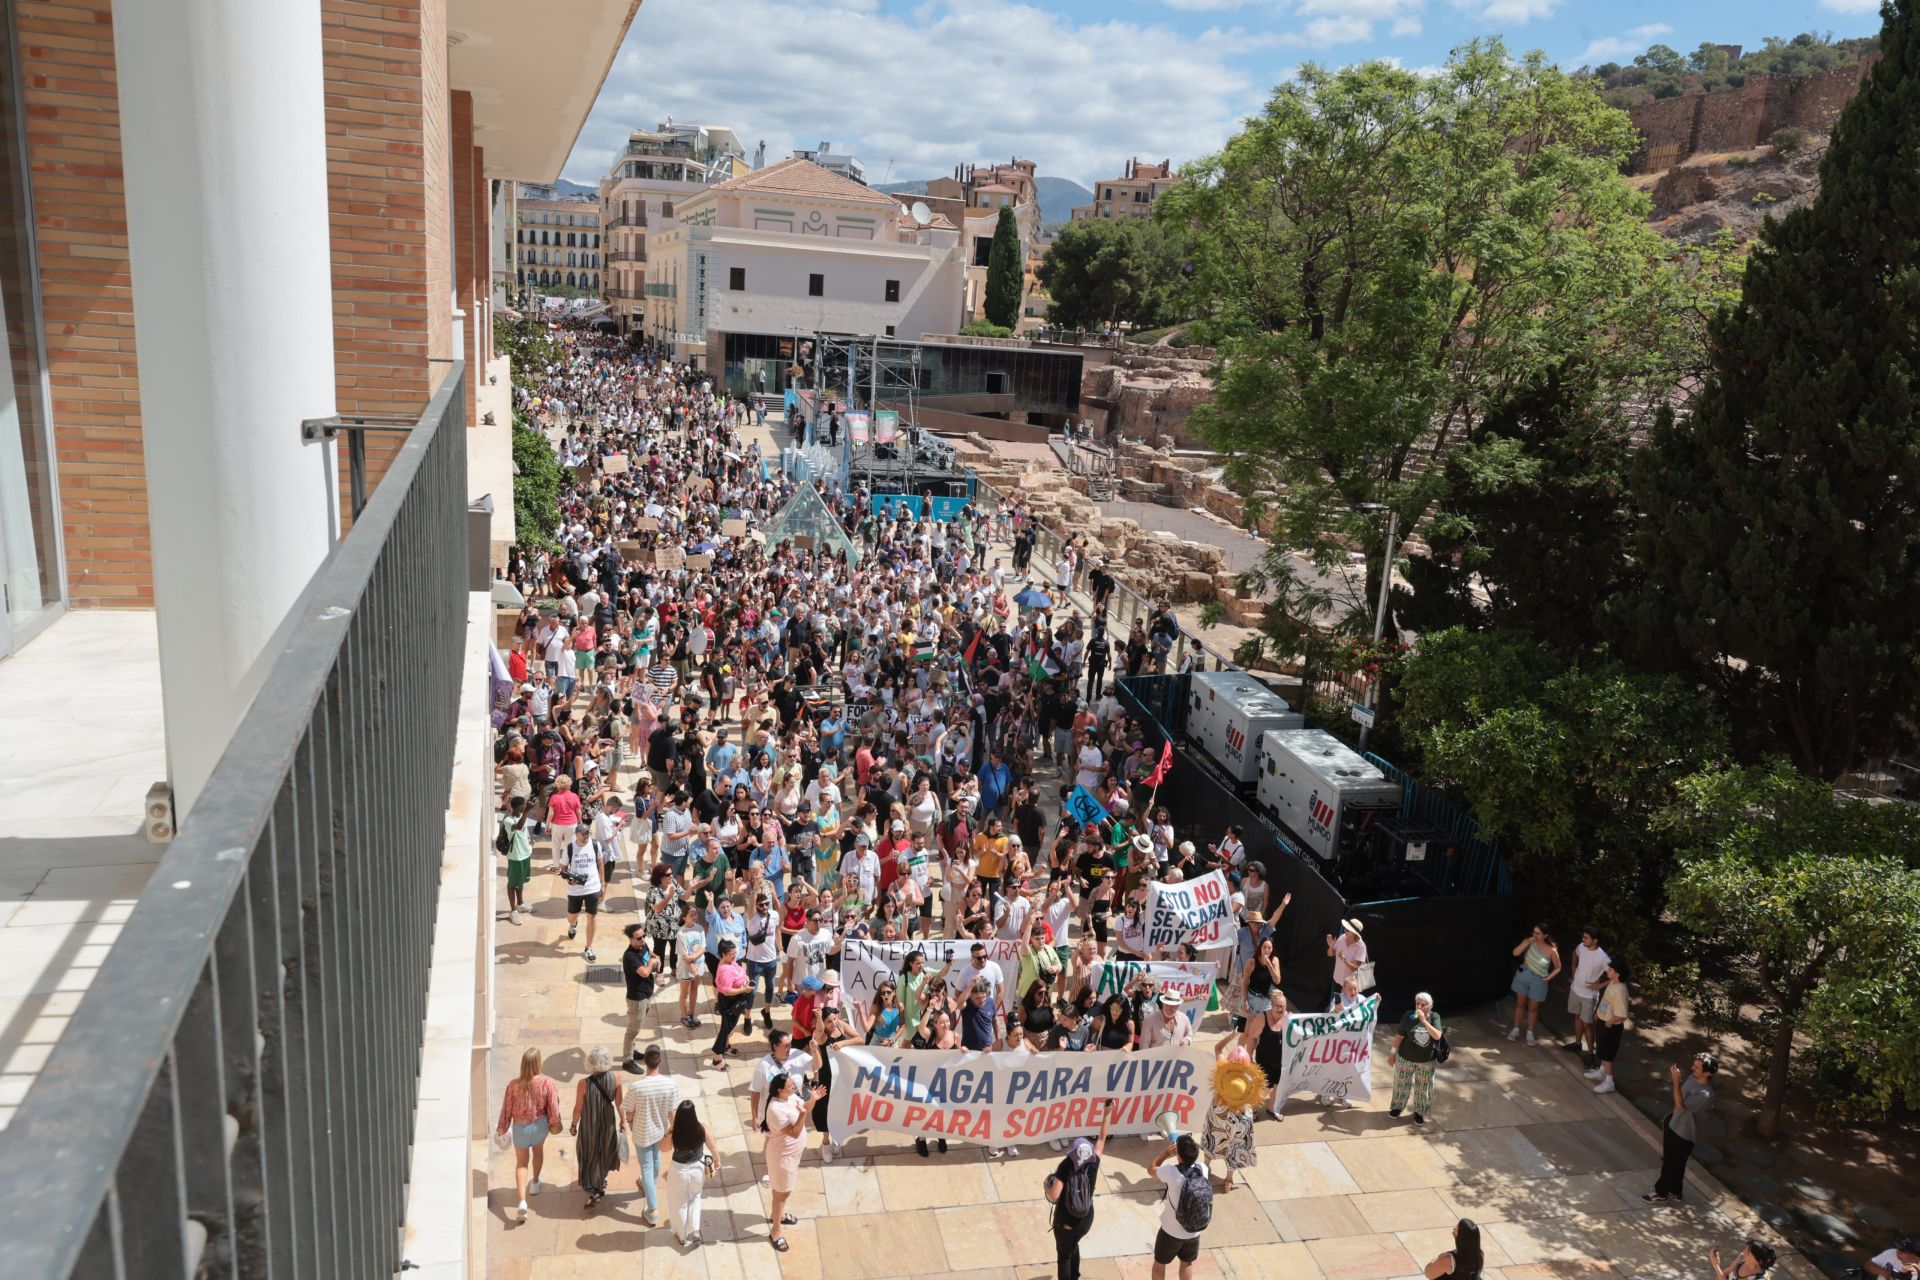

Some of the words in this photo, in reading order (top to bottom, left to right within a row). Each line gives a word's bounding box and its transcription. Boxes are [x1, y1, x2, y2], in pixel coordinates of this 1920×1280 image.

[1225, 742, 1242, 763] MUNDO
[1308, 815, 1331, 841] MUNDO
[1156, 890, 1191, 909] ESTO
[1194, 880, 1221, 905] NO
[1152, 910, 1176, 927] SE
[1178, 899, 1228, 929] ACABA
[1149, 928, 1185, 946] HOY
[1189, 921, 1219, 944] 29J
[1309, 1039, 1370, 1064] LUCHA
[853, 1056, 993, 1104] MÁLAGA
[1006, 1066, 1092, 1104] PARA
[1106, 1059, 1198, 1096] VIVIR,
[848, 1093, 895, 1126] NO
[902, 1106, 991, 1140] PARA
[1002, 1093, 1195, 1138] SOBREVIVIR
